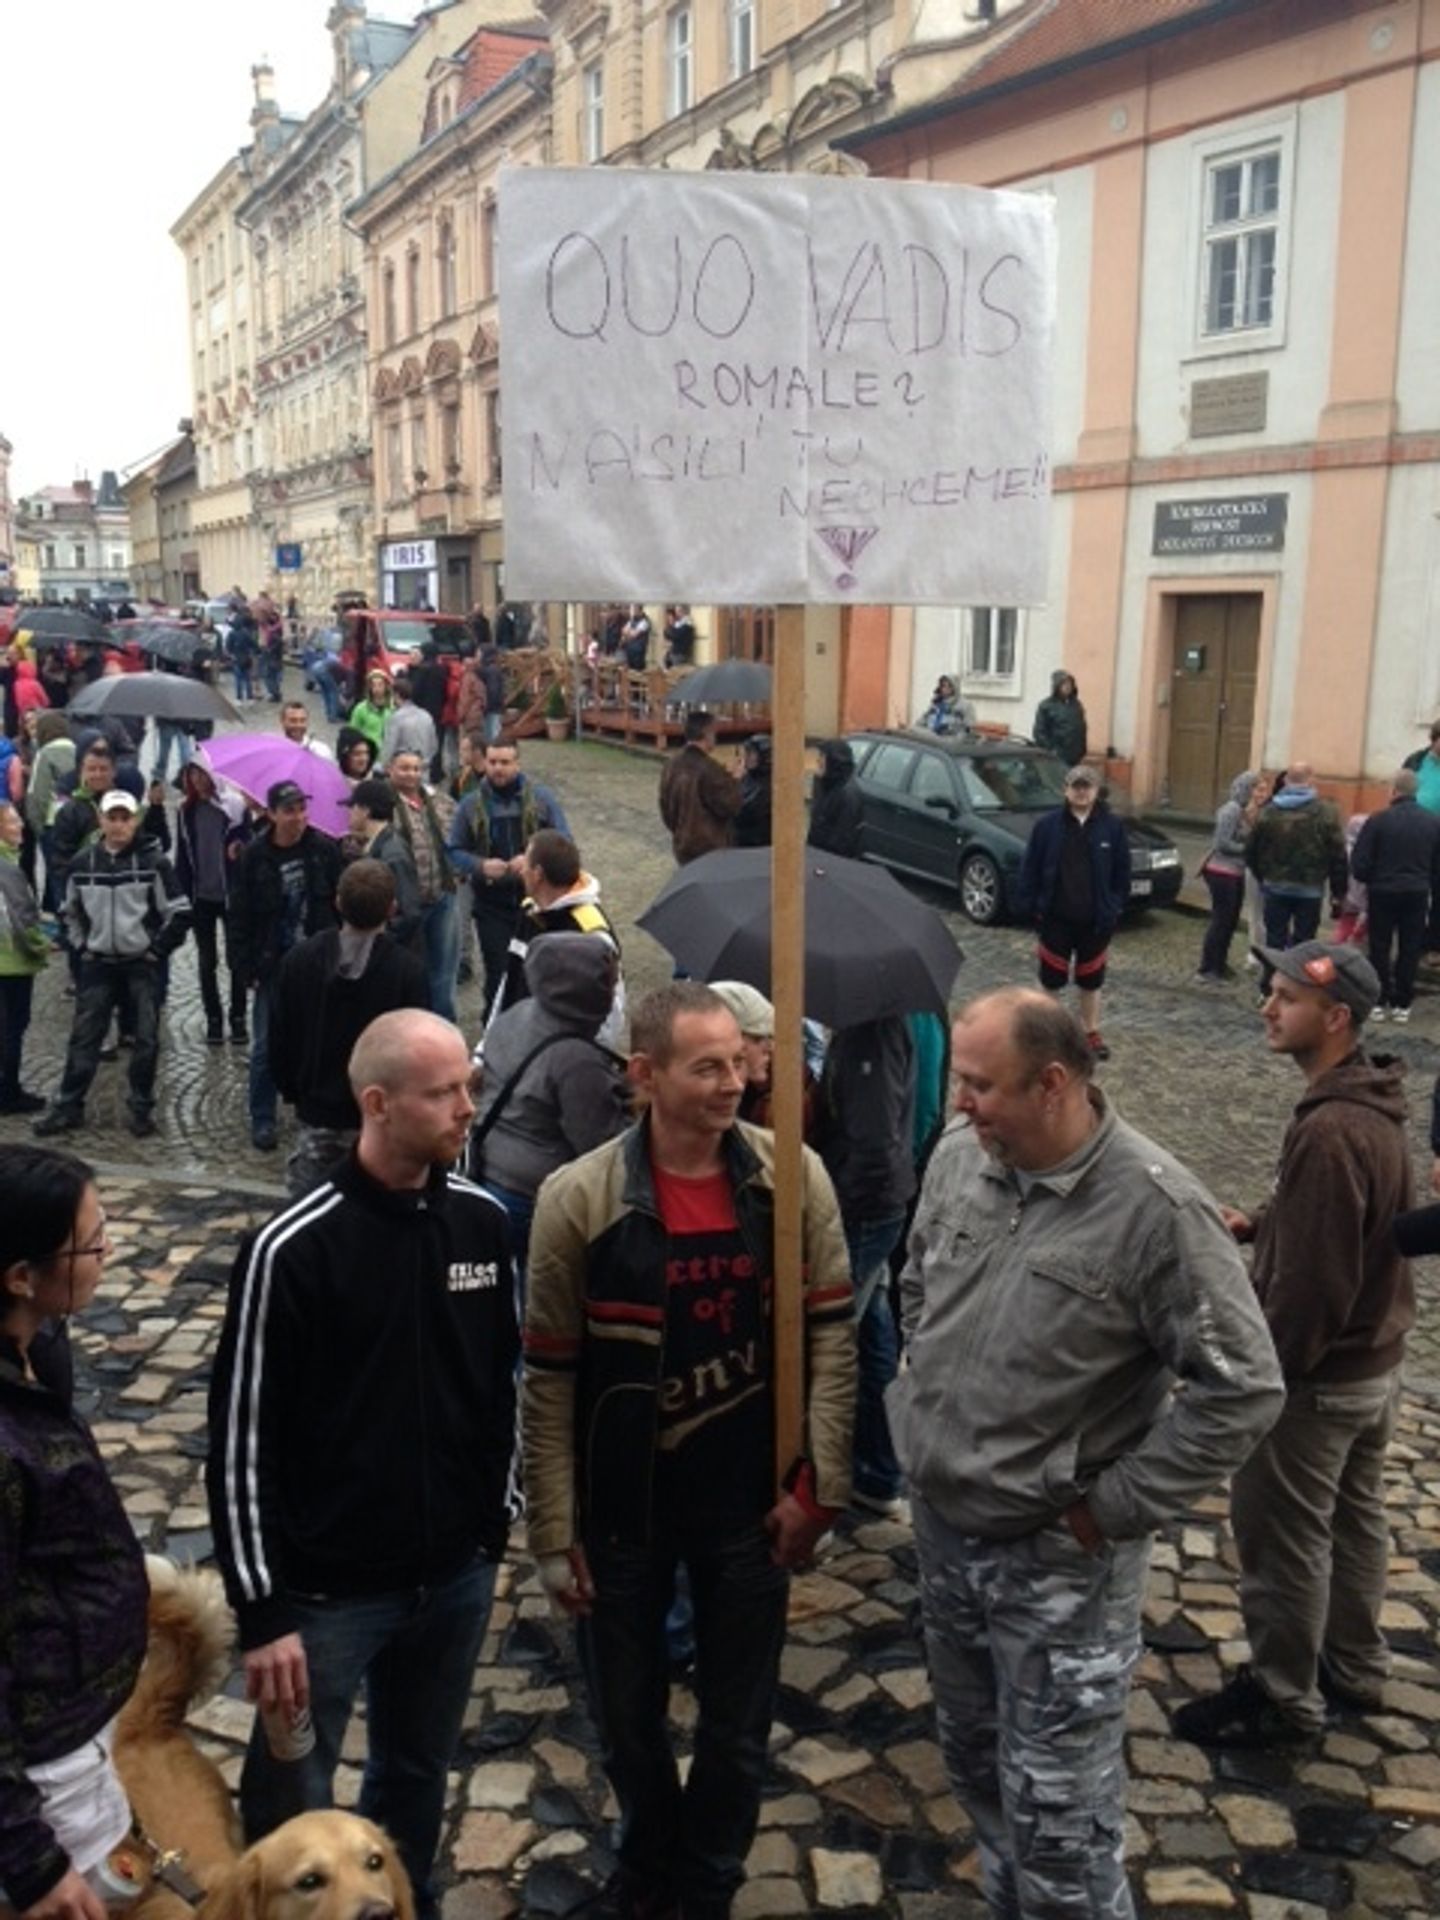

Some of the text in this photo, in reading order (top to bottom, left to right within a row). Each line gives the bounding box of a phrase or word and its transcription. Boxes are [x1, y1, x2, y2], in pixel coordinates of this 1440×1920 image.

[547, 232, 1024, 357] QUO VADIS
[792, 429, 863, 468] TU
[393, 544, 425, 565] IRIS
[693, 1289, 735, 1335] of
